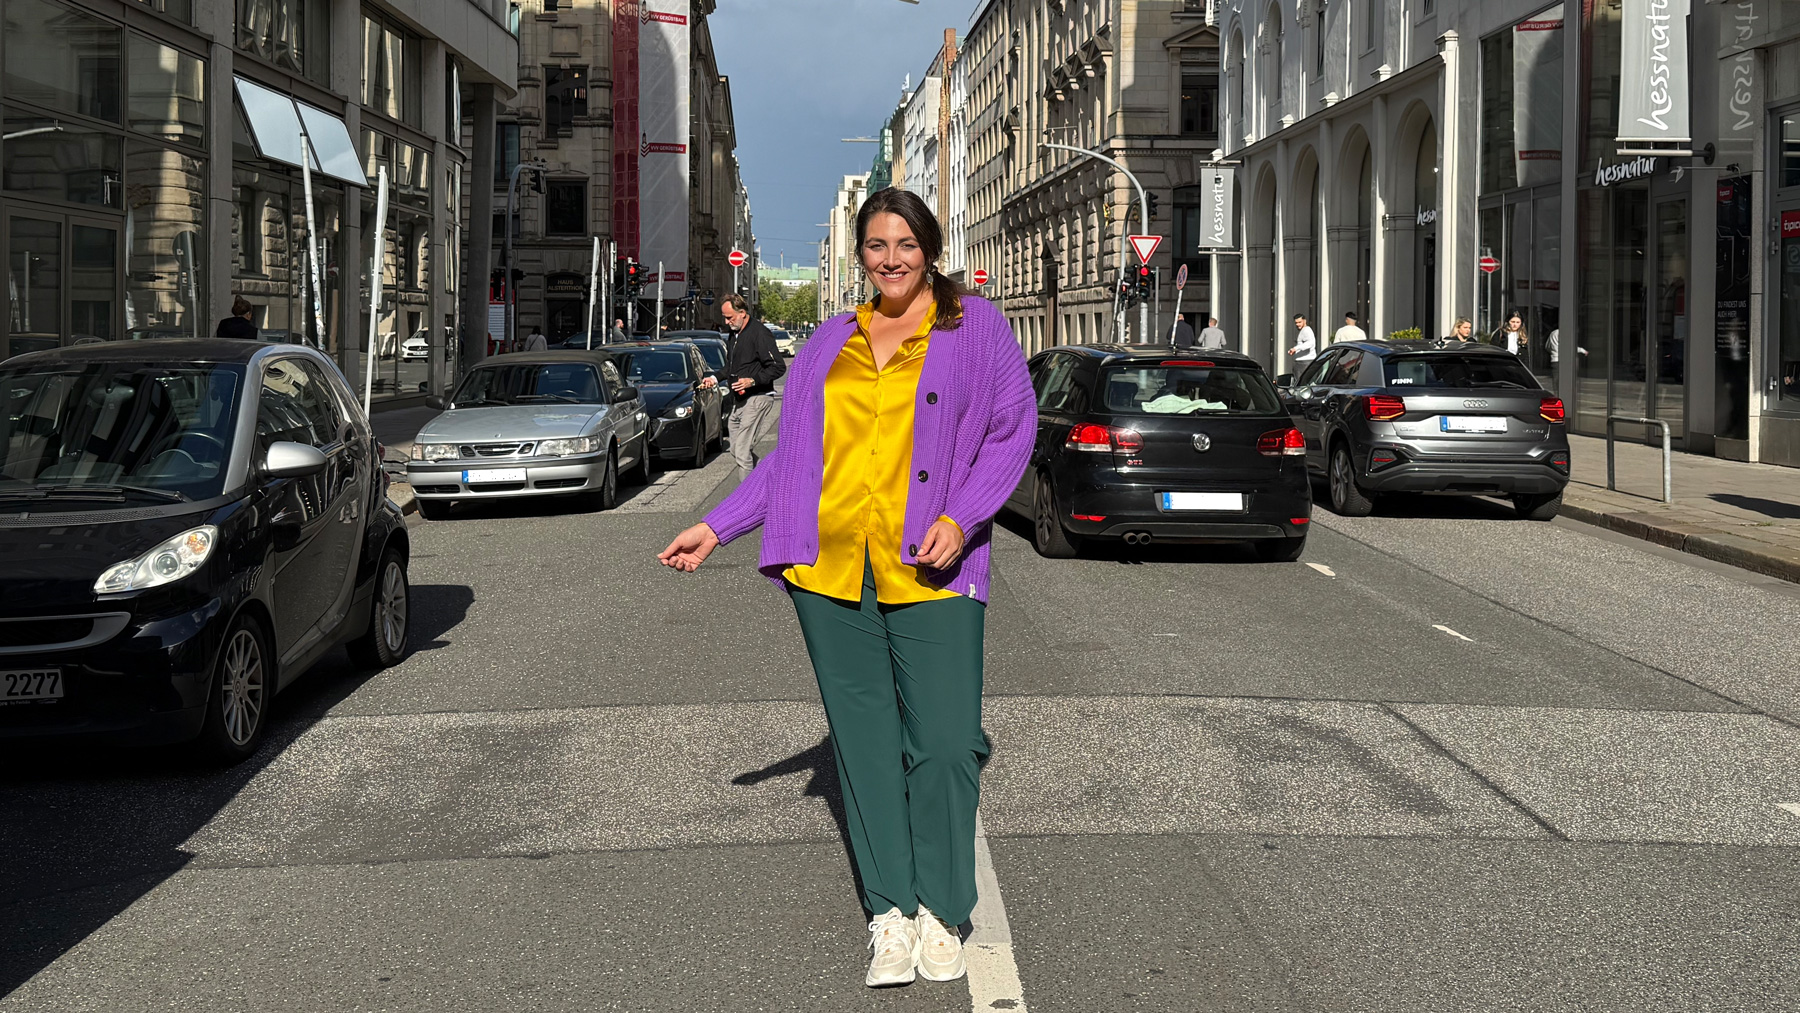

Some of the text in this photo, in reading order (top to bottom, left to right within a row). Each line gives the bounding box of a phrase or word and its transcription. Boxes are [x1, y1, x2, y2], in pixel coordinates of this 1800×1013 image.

[1595, 155, 1657, 187] hessnatur
[1391, 377, 1413, 385] FINN
[5, 672, 60, 697] 2277
